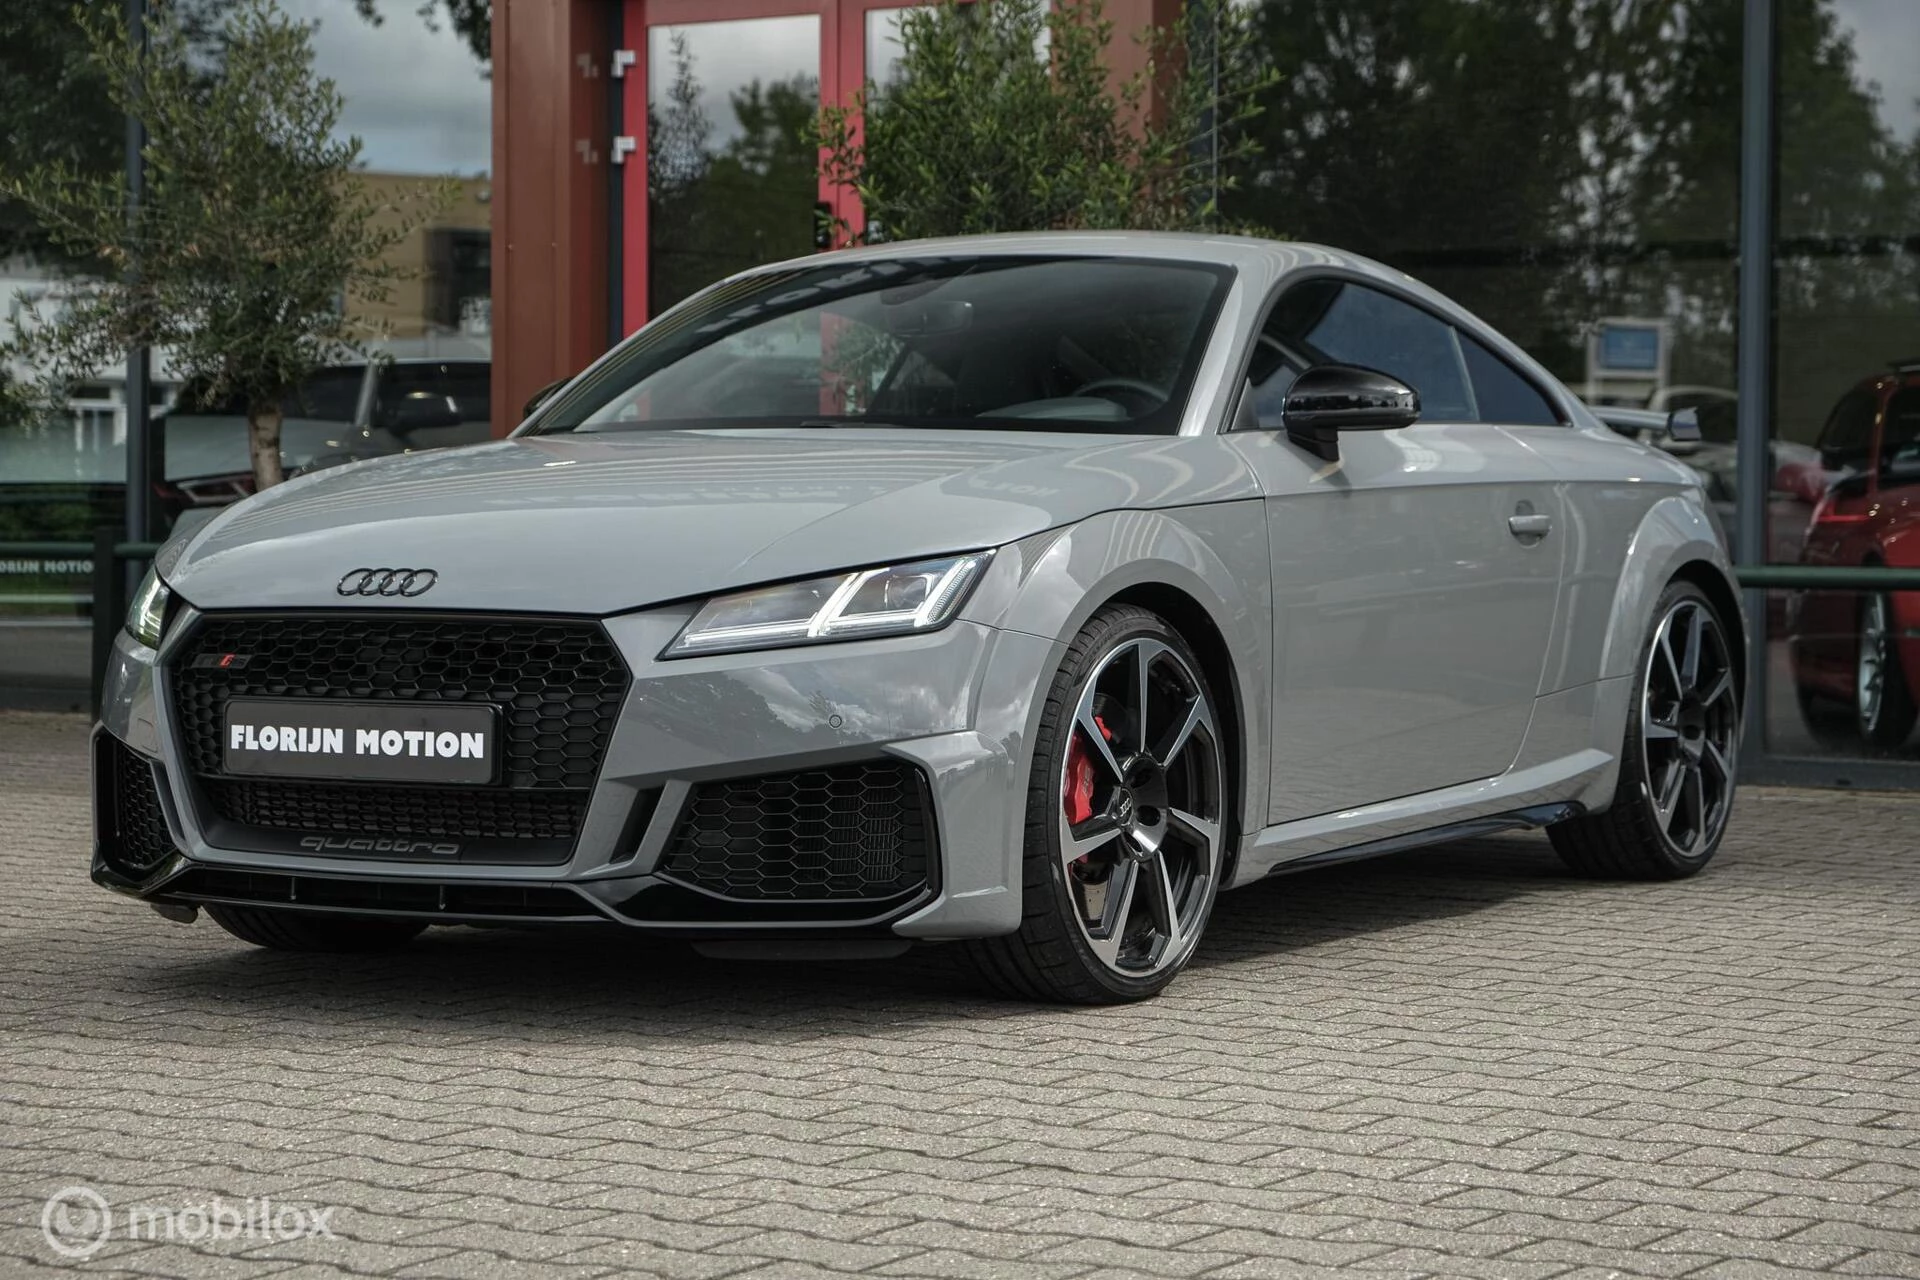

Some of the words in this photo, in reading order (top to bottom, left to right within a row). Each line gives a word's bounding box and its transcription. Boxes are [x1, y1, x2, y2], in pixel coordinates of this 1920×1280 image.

[231, 724, 344, 754] FLORIJN
[355, 729, 484, 759] MOTION
[300, 836, 460, 855] quattro
